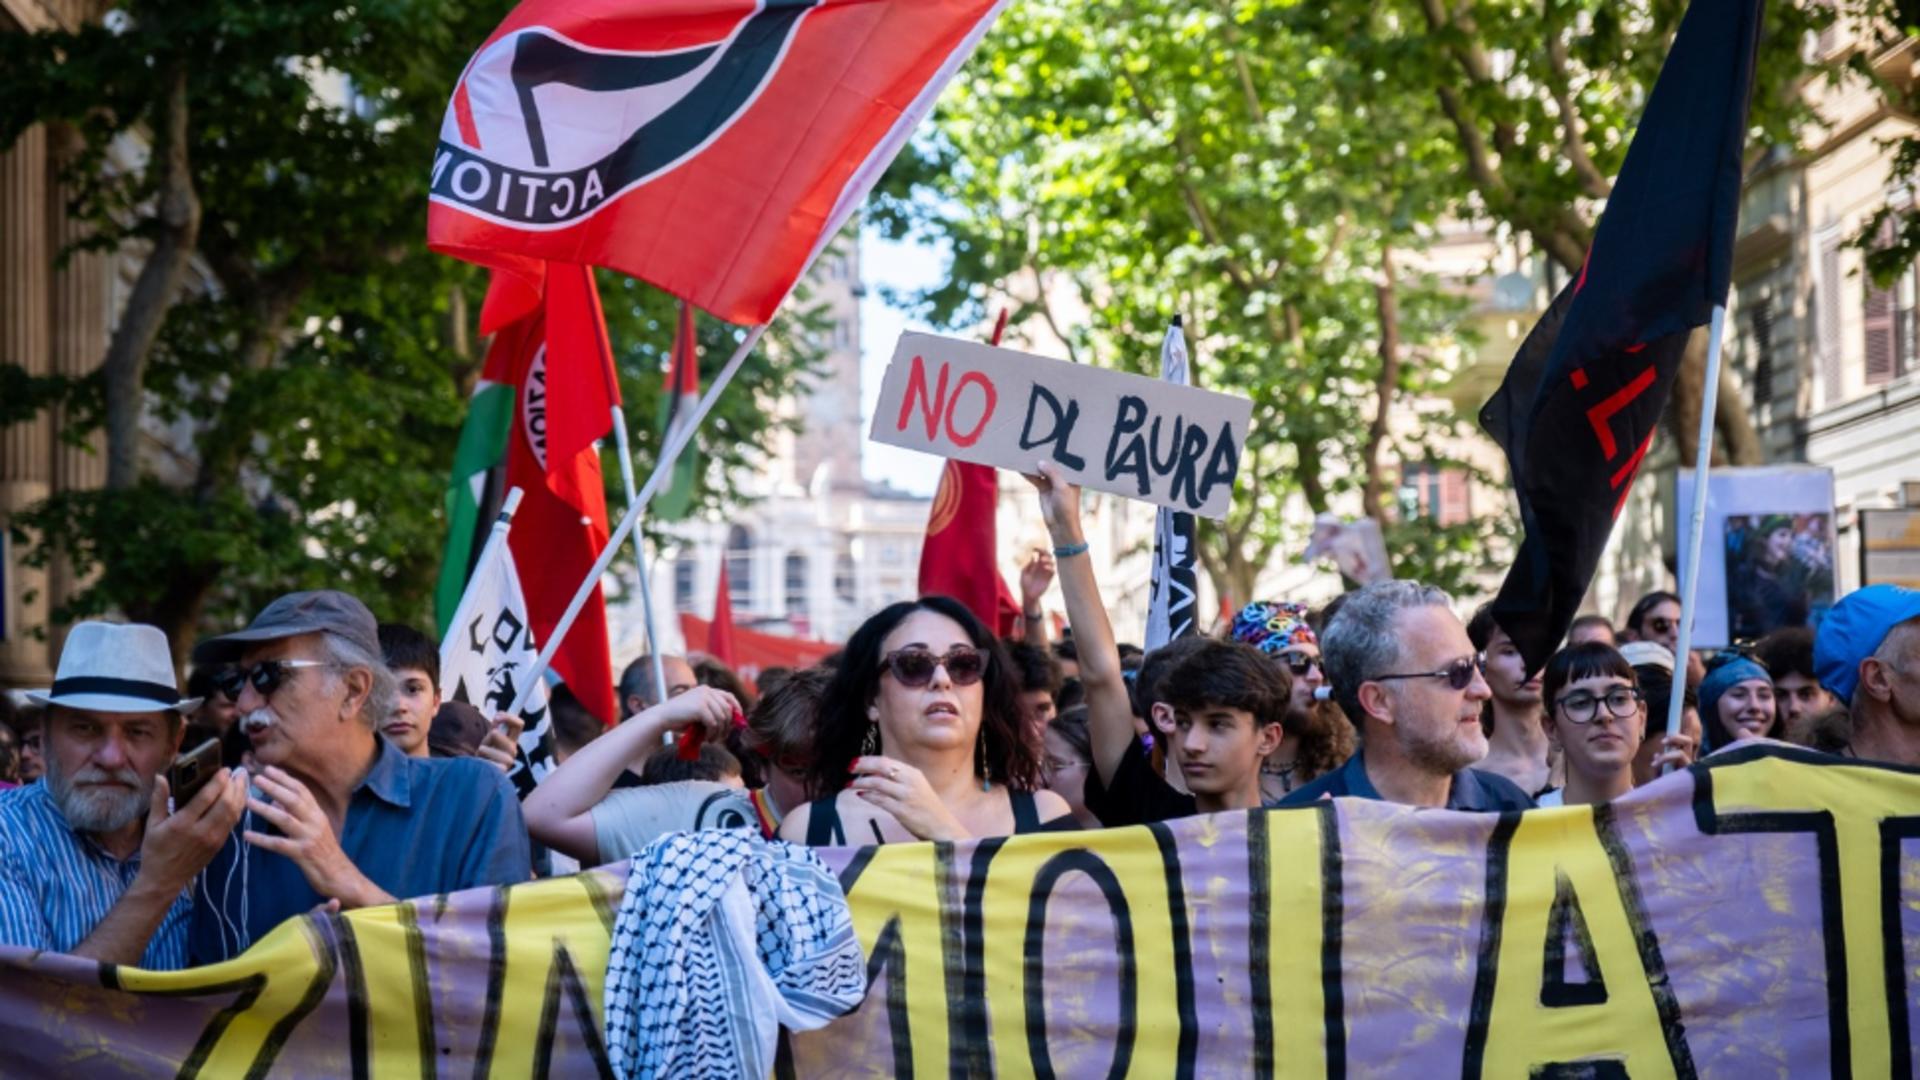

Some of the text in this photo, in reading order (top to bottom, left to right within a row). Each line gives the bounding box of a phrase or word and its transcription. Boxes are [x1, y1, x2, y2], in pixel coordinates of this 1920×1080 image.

[896, 354, 1239, 510] NO DL PAURA
